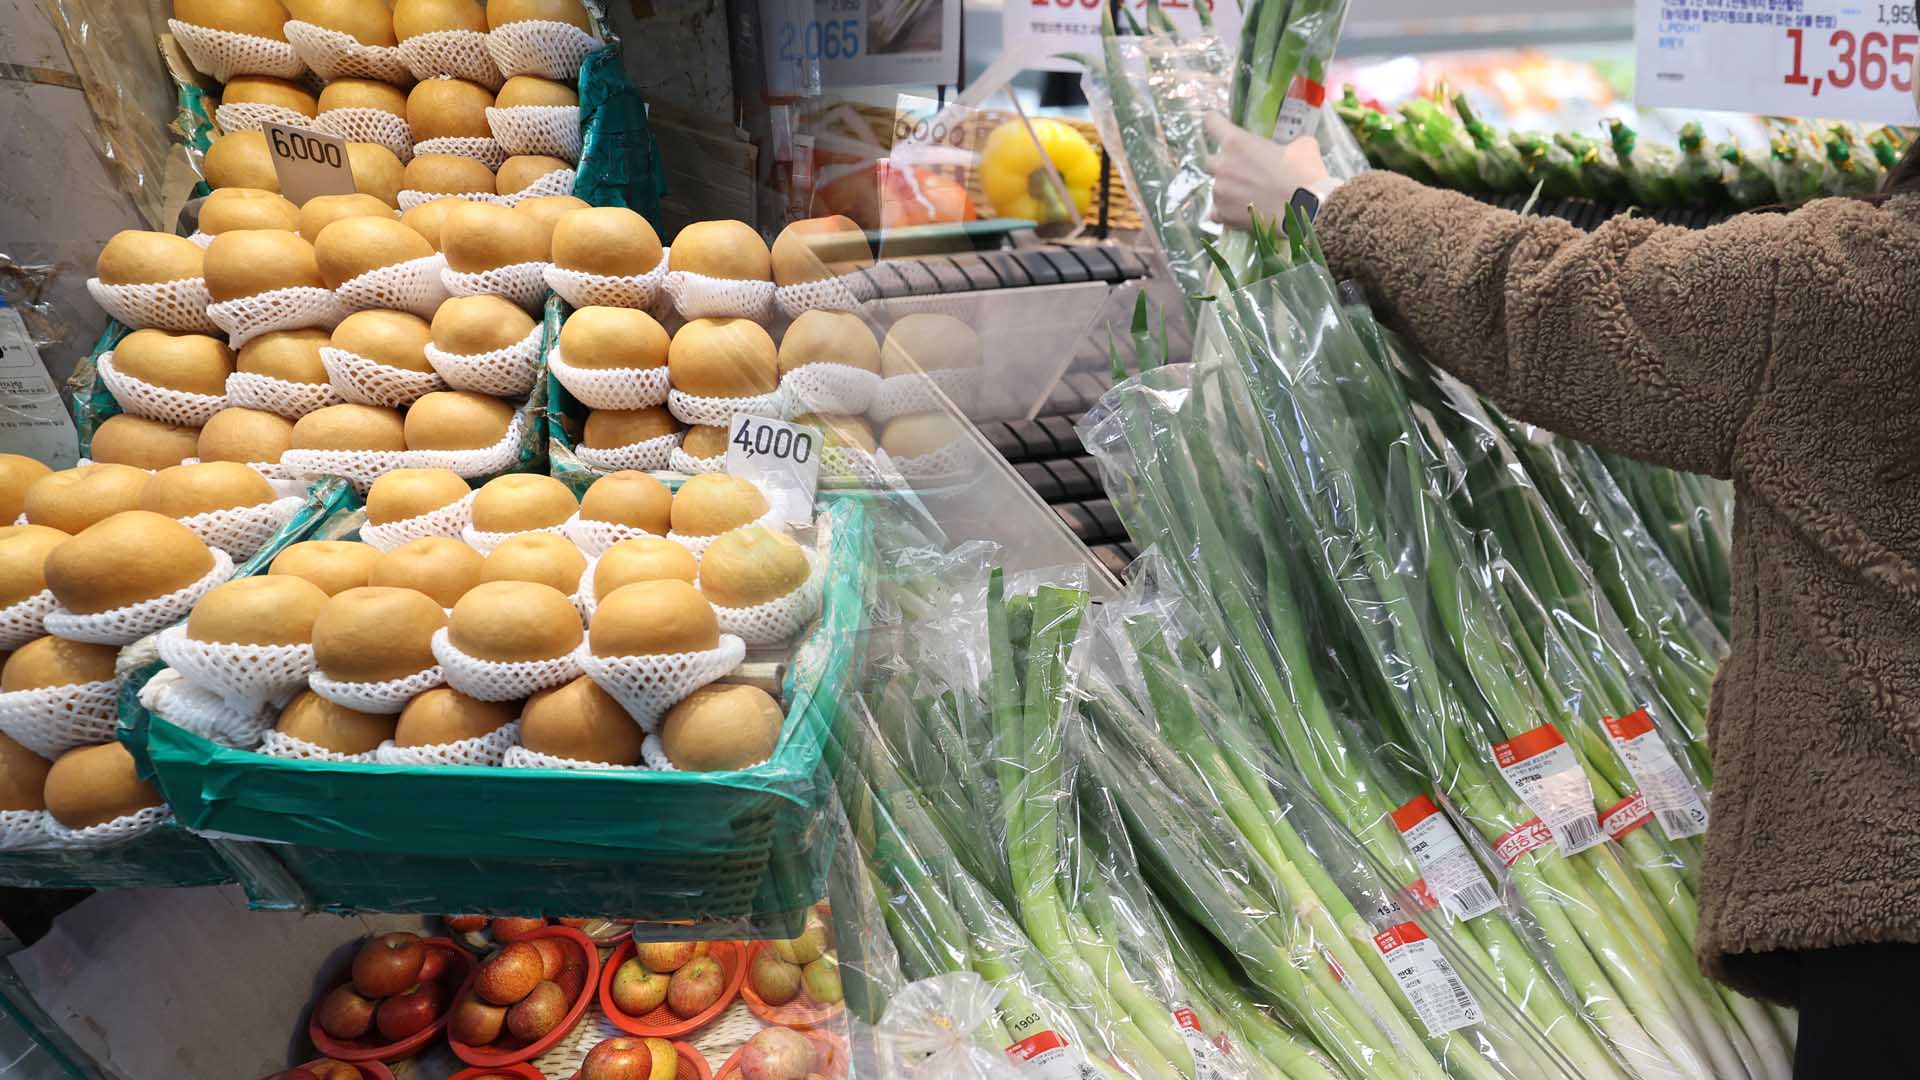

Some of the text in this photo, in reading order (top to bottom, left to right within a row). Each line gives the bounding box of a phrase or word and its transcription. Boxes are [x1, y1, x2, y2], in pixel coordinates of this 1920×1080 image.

[779, 19, 860, 66] 2,065
[1784, 28, 1919, 97] 1,365
[272, 128, 342, 169] 6,000
[733, 419, 812, 464] 4,000
[1014, 1012, 1040, 1031] 1903
